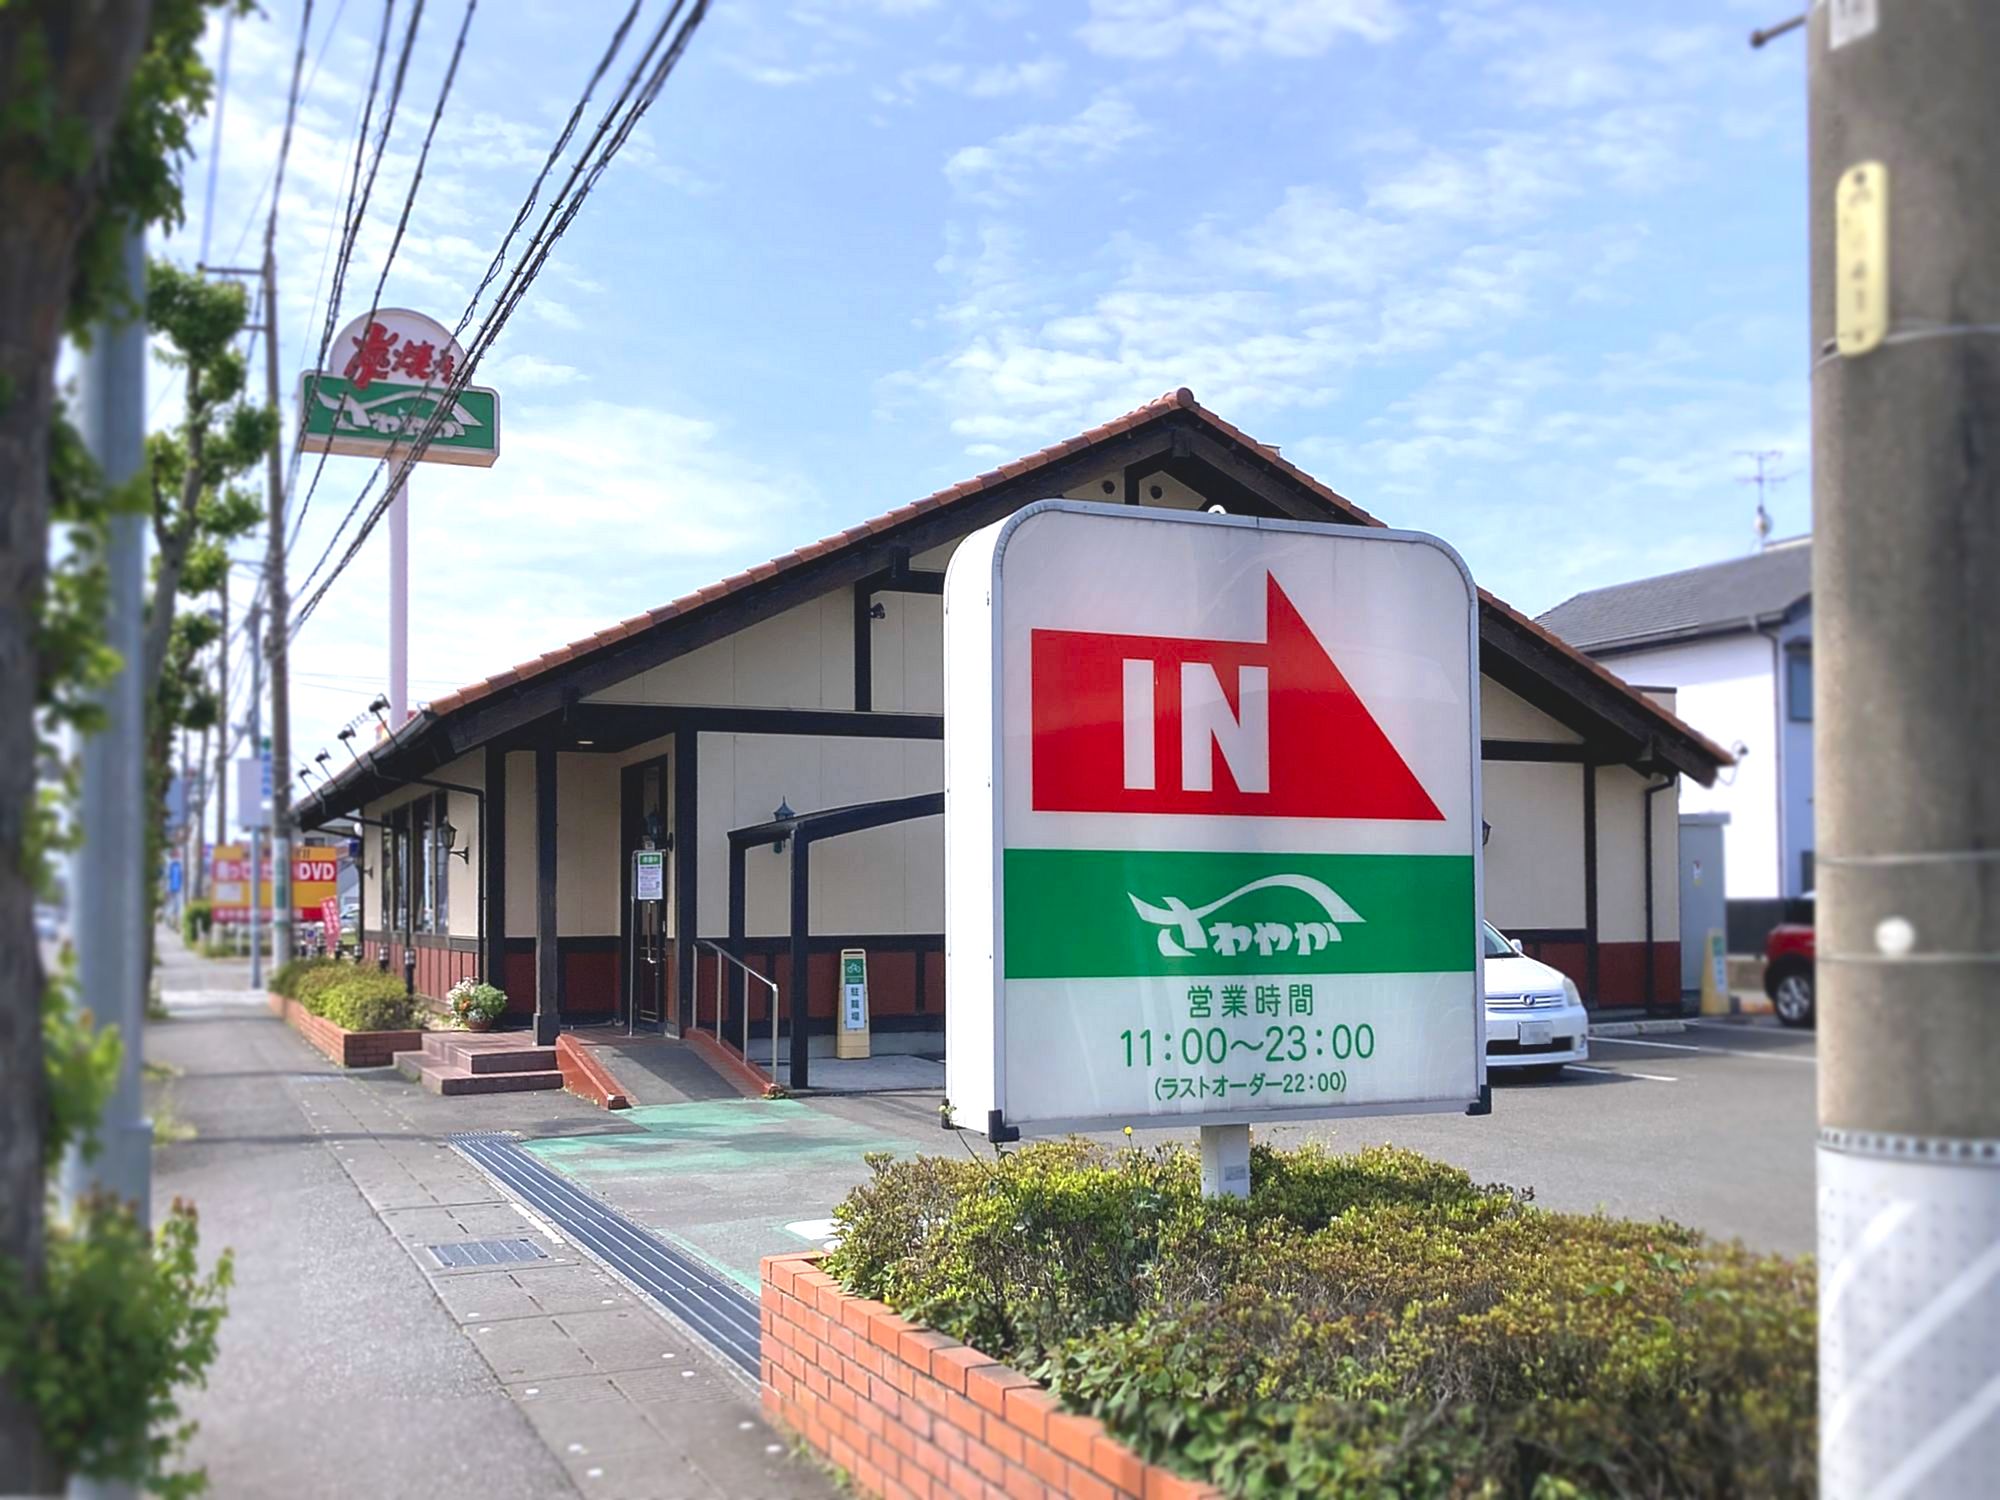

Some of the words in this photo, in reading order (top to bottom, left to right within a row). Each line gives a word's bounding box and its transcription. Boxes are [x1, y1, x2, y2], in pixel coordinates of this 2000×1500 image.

[1123, 658, 1270, 793] IN
[299, 862, 335, 880] DVD
[1127, 873, 1367, 957] さわやか
[1187, 983, 1314, 1018] 営業時間
